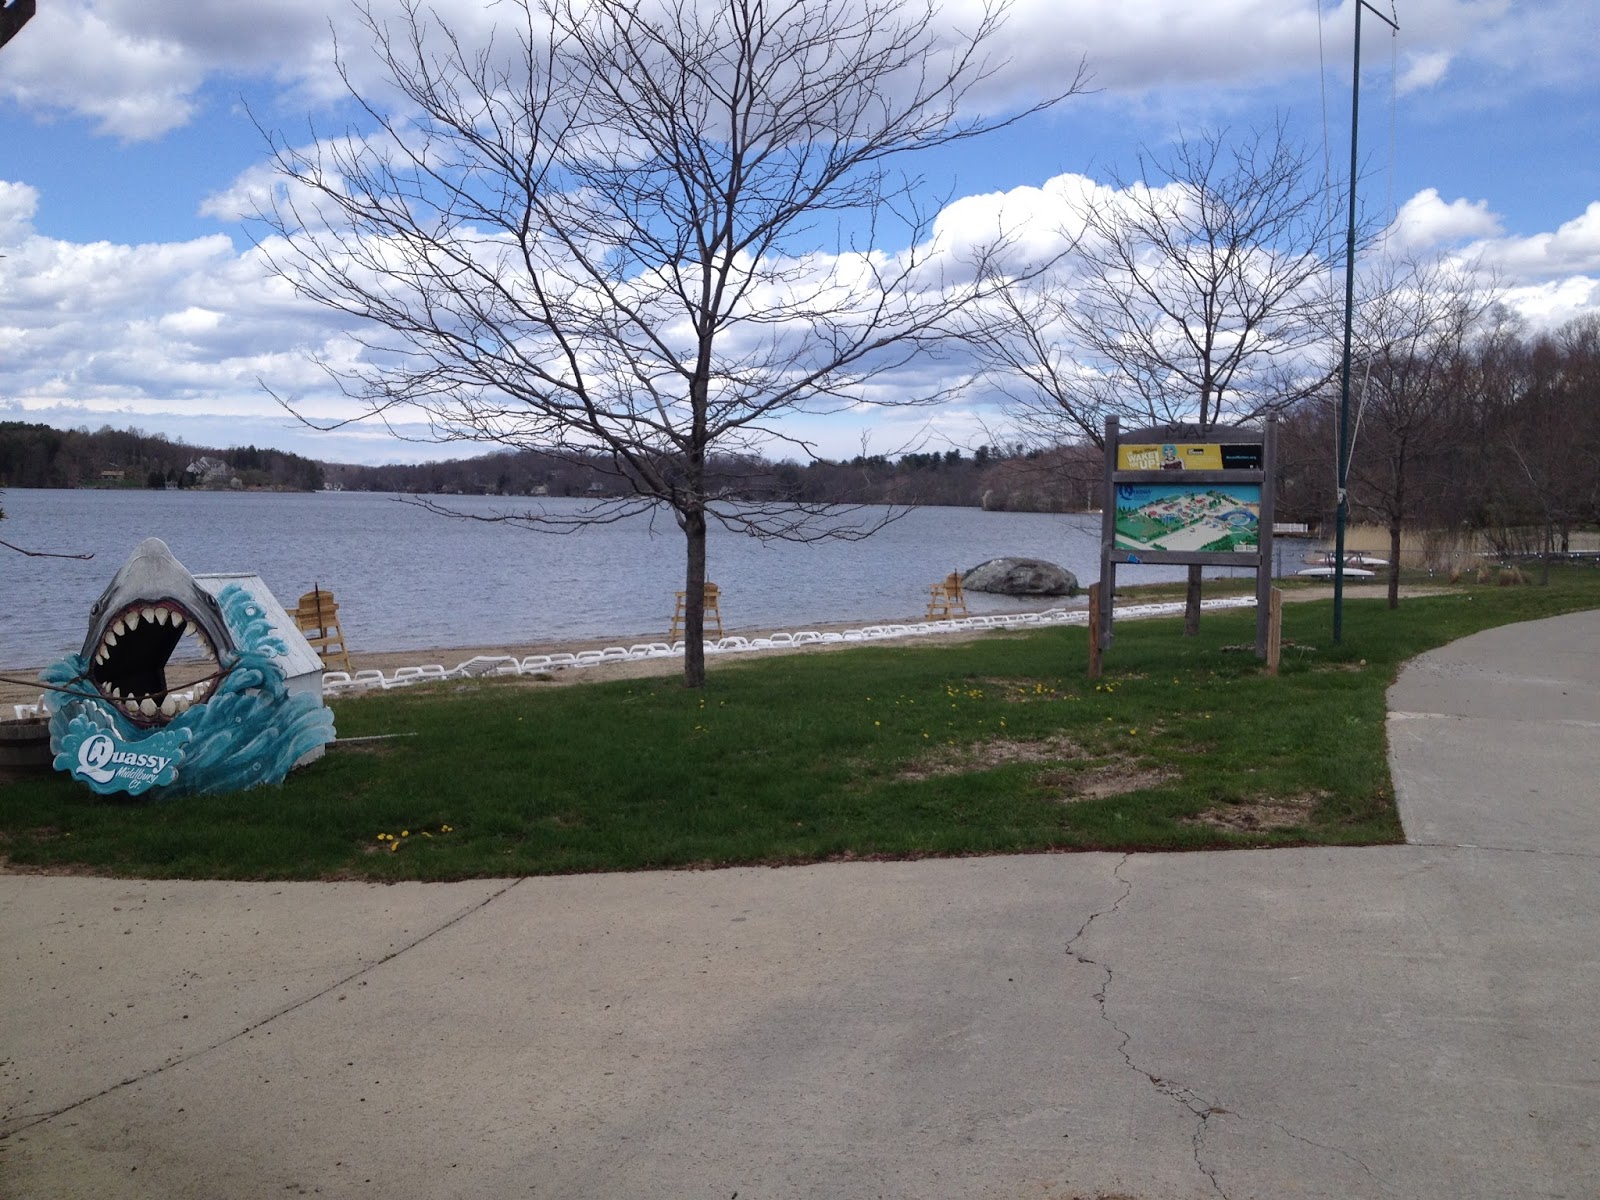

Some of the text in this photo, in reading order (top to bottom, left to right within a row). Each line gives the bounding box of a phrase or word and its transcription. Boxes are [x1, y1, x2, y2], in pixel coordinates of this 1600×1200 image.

[1165, 424, 1213, 440] MAP
[1127, 452, 1155, 463] WAKE
[76, 735, 173, 784] Quassy
